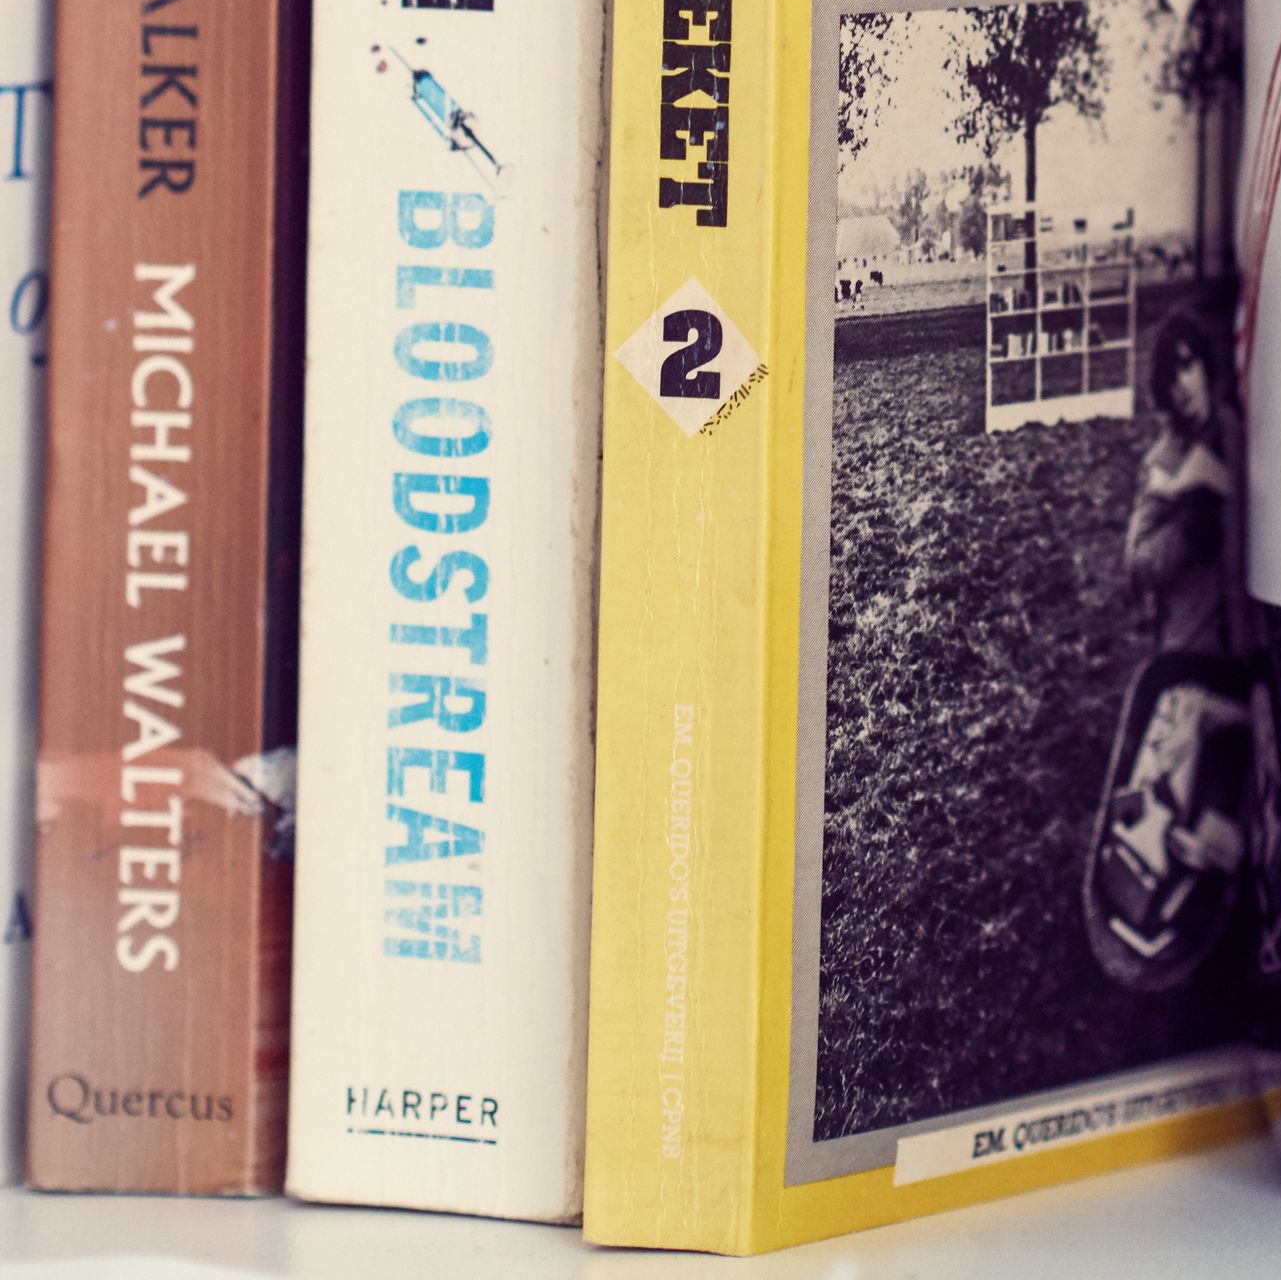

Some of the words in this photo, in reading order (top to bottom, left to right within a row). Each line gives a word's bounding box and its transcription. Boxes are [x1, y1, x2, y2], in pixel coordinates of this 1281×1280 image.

[126, 262, 197, 608] MICHAEL
[660, 309, 723, 399] 2
[383, 189, 496, 966] BLOODSTREAM
[116, 635, 187, 973] WALTERS
[48, 1072, 234, 1124] Quercus
[346, 1085, 499, 1128] HARPER
